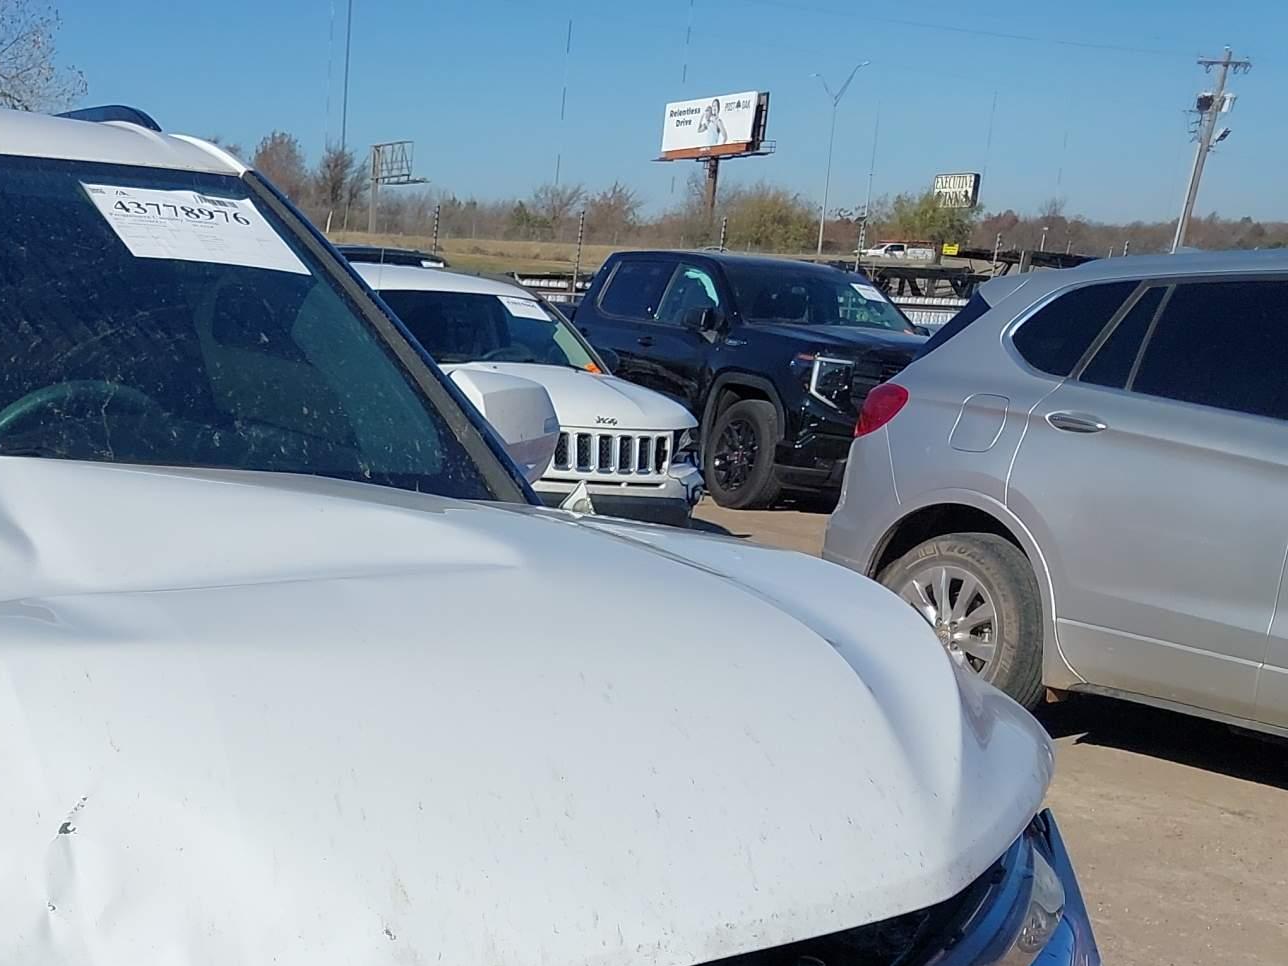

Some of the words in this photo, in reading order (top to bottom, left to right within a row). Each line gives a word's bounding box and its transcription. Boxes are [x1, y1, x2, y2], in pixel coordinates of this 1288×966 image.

[669, 107, 701, 118] Relentless
[675, 118, 692, 128] Drive
[936, 175, 973, 189] EXECUTIVE
[113, 199, 251, 226] 43778976
